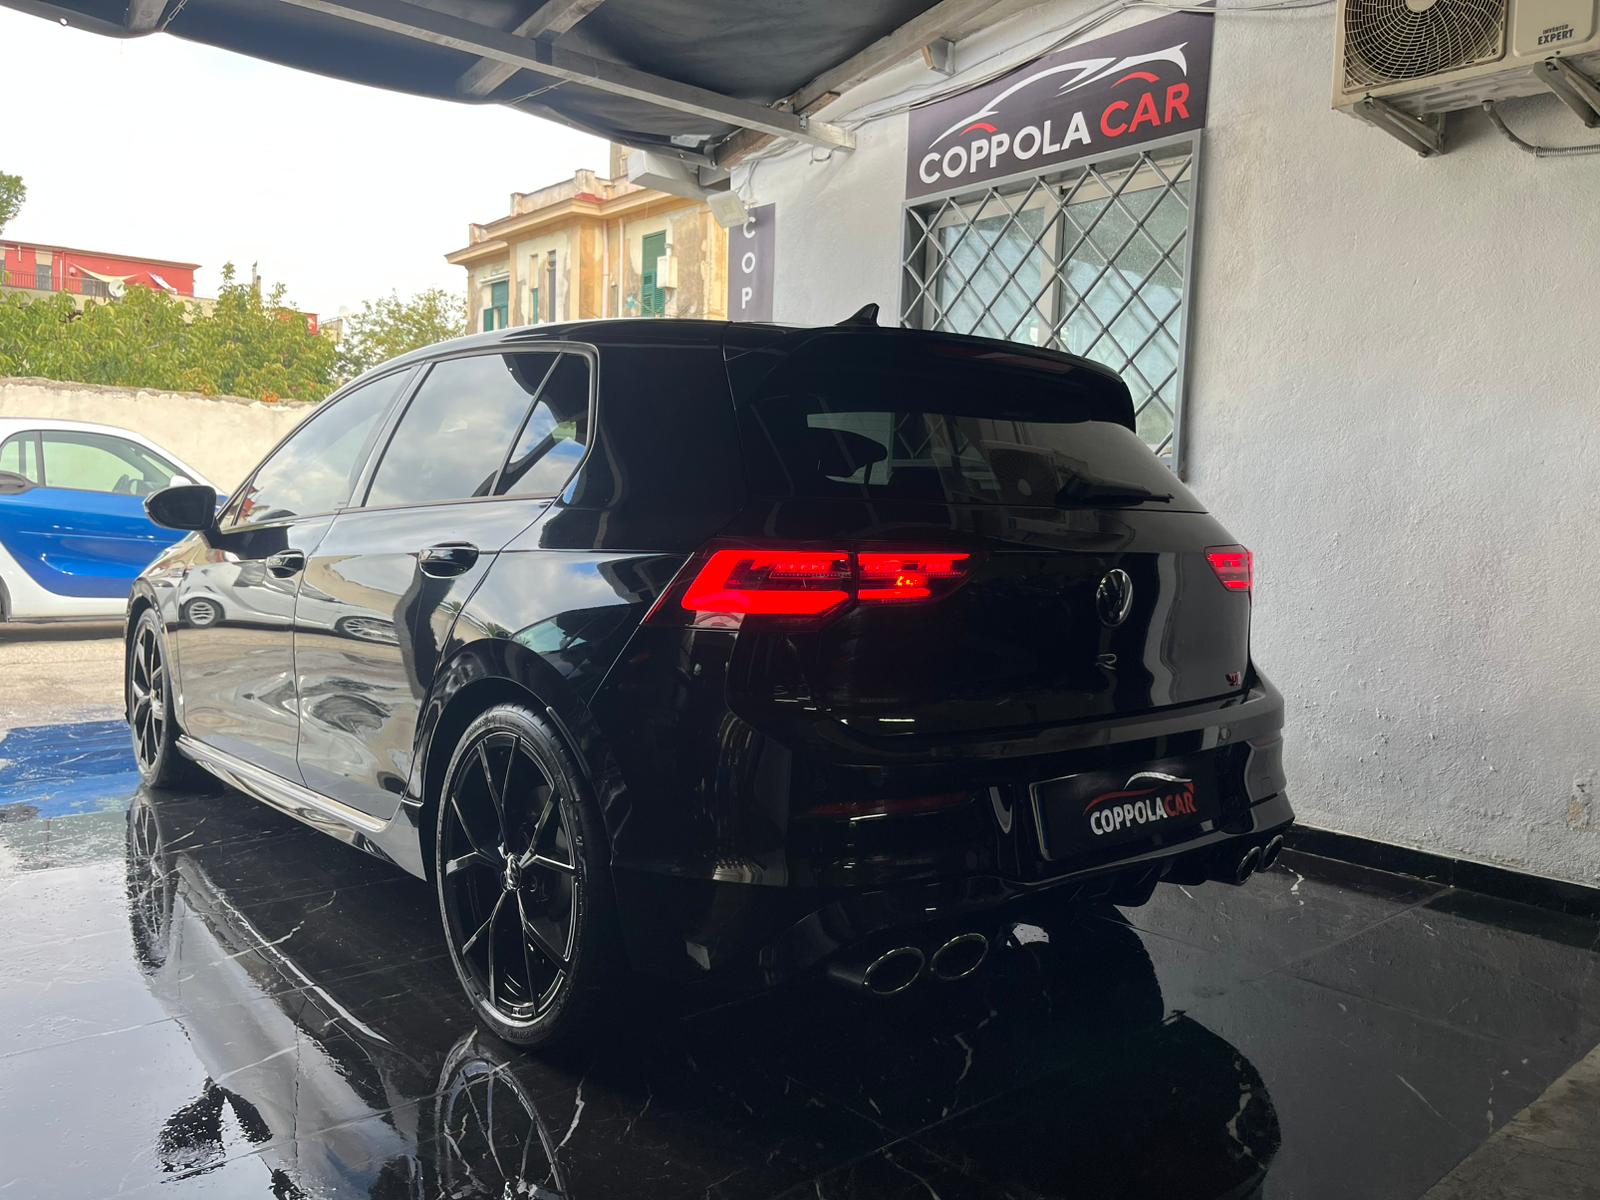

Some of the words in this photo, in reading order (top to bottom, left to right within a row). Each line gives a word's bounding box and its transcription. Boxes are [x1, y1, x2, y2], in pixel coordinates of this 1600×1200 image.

[1537, 28, 1574, 45] EXPERT
[919, 111, 1091, 184] COPPOLA
[1100, 83, 1190, 137] CAR
